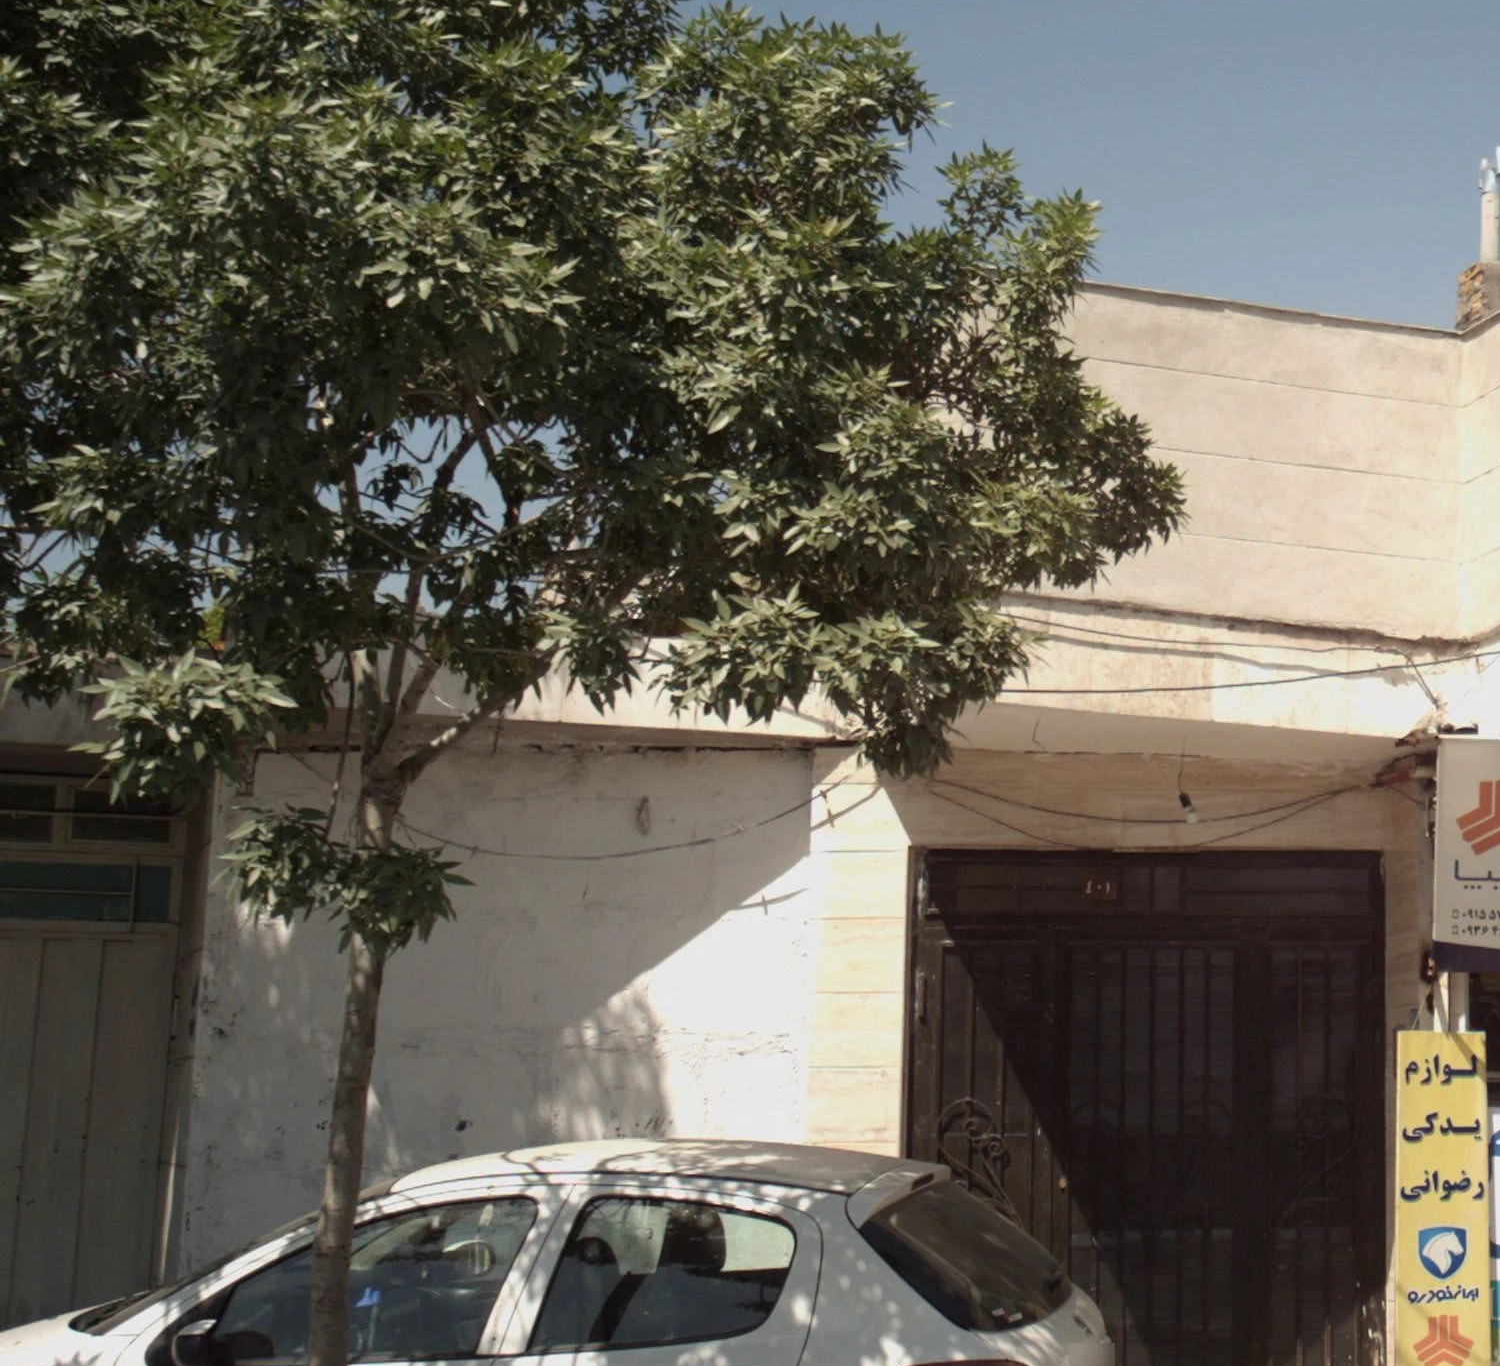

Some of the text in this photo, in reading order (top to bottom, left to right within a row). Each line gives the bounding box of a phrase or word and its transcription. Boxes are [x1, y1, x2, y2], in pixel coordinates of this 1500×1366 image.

[1405, 1053, 1478, 1085] لوازم
[1402, 1112, 1482, 1143] یدکی
[1400, 1170, 1485, 1201] رضوانی
